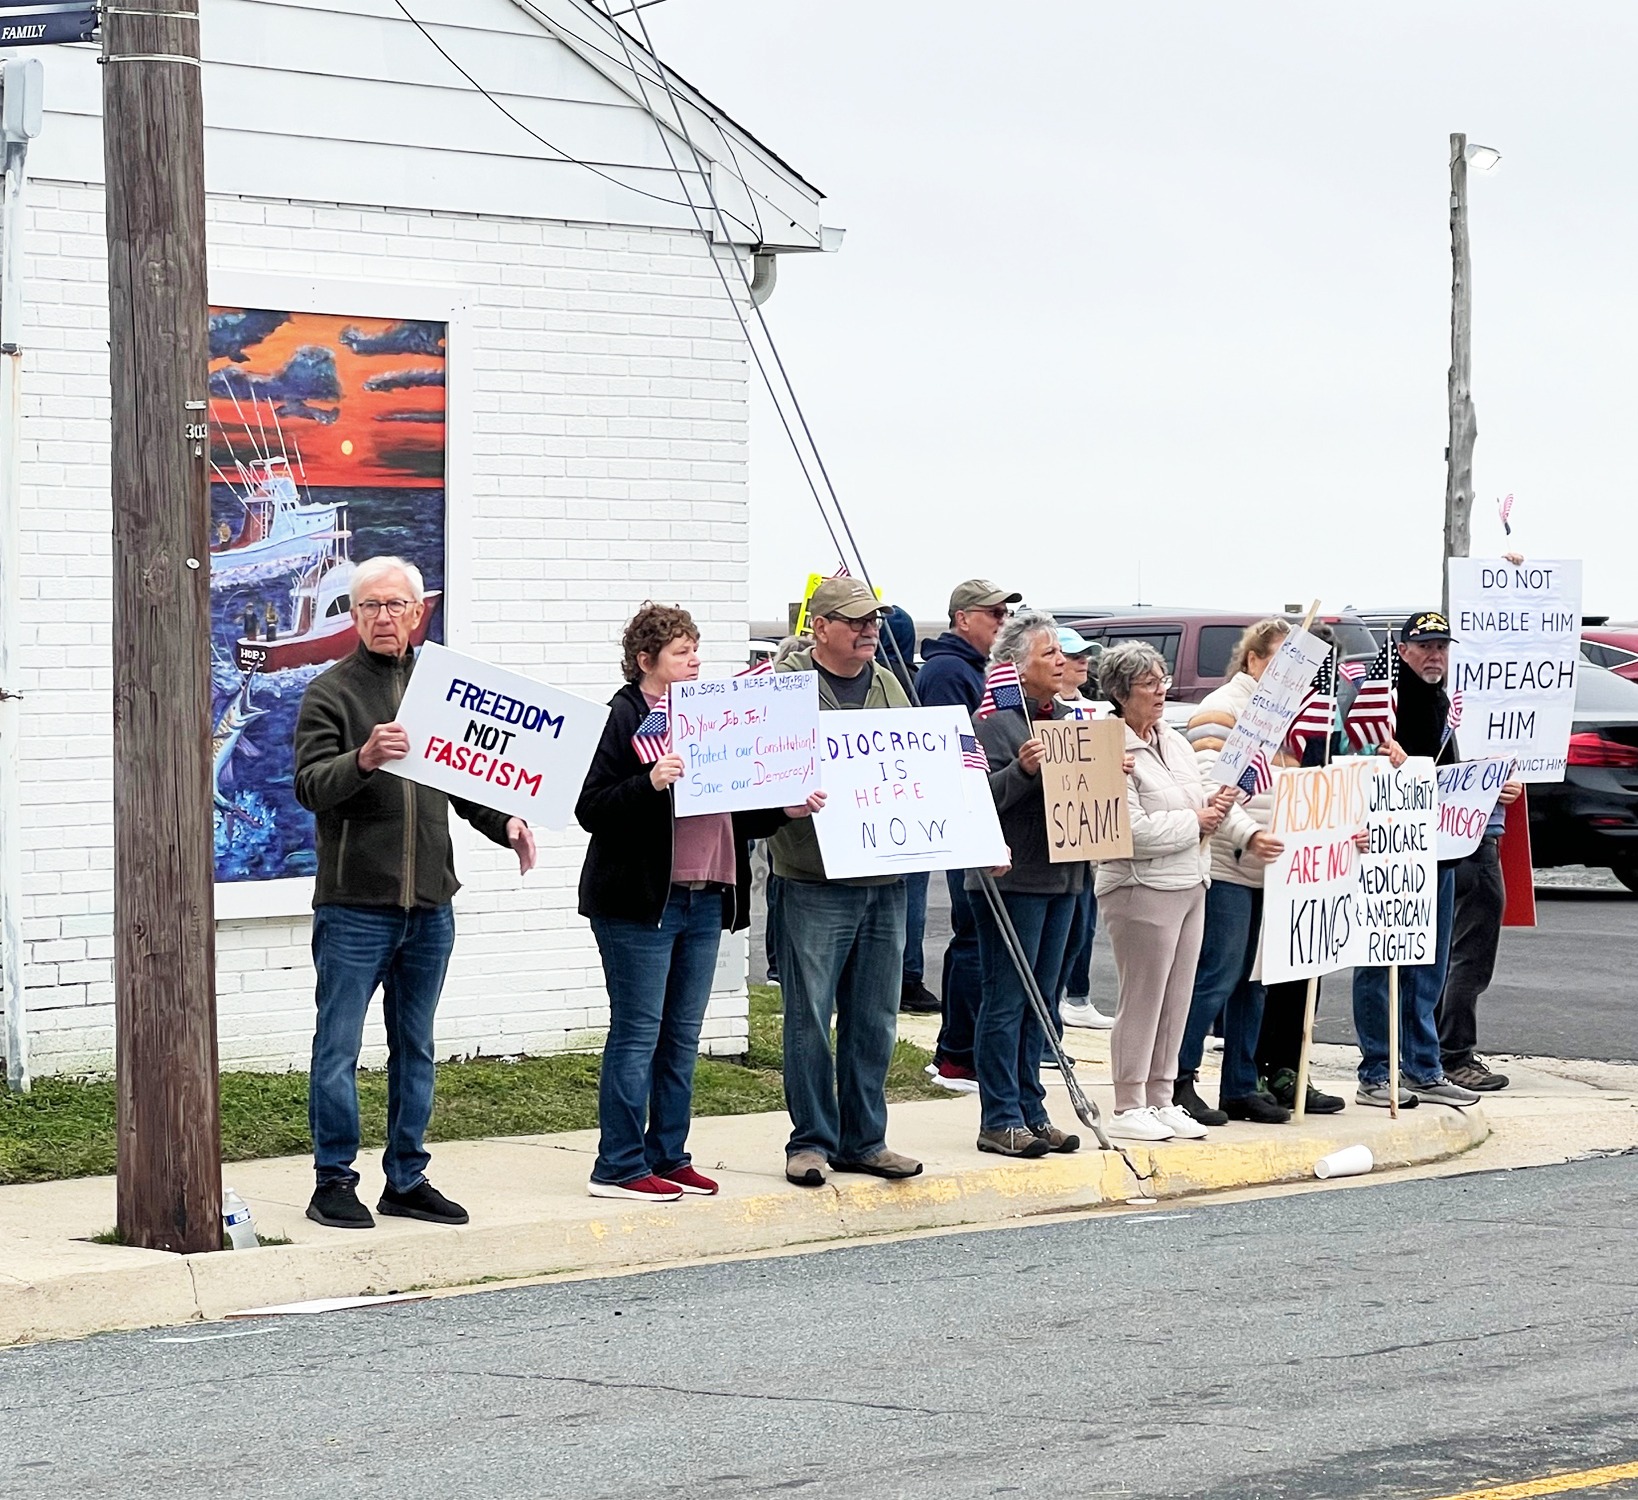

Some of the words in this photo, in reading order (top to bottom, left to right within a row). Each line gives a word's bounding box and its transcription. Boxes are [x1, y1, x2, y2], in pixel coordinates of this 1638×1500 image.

[1, 24, 47, 40] FAMILY
[184, 423, 208, 439] 303
[1482, 569, 1508, 589] DO
[1515, 569, 1553, 589] NOT
[1461, 611, 1530, 632] ENABLE
[1541, 613, 1574, 632] HIM
[1455, 661, 1575, 691] IMPEACH
[681, 686, 696, 699] NO
[446, 678, 565, 739] FREEDOM
[464, 720, 516, 755] NOT
[678, 714, 695, 741] Do
[696, 714, 718, 742] Your
[1487, 711, 1536, 740] HIM
[688, 743, 728, 769] Protect
[735, 744, 754, 757] our
[755, 728, 817, 756] Constitution!
[821, 730, 947, 761] DIOCRACY
[424, 736, 543, 797] FASCISM
[690, 773, 723, 797] Save
[731, 777, 752, 791] our
[753, 757, 814, 786] Democracy!
[879, 760, 907, 781] IS
[1510, 759, 1546, 772] NVICT
[1546, 758, 1567, 770] HIM
[855, 782, 924, 808] HERE
[1062, 774, 1071, 792] IS
[1077, 773, 1089, 792] A
[1272, 761, 1368, 835] PRESIDENTS
[863, 817, 947, 849] NOW
[1052, 797, 1120, 848] SCAM!
[1436, 803, 1487, 839] MOCR
[1286, 845, 1322, 885] ARE
[1289, 894, 1351, 967] KINGS
[1368, 930, 1426, 964] RIGHTS
